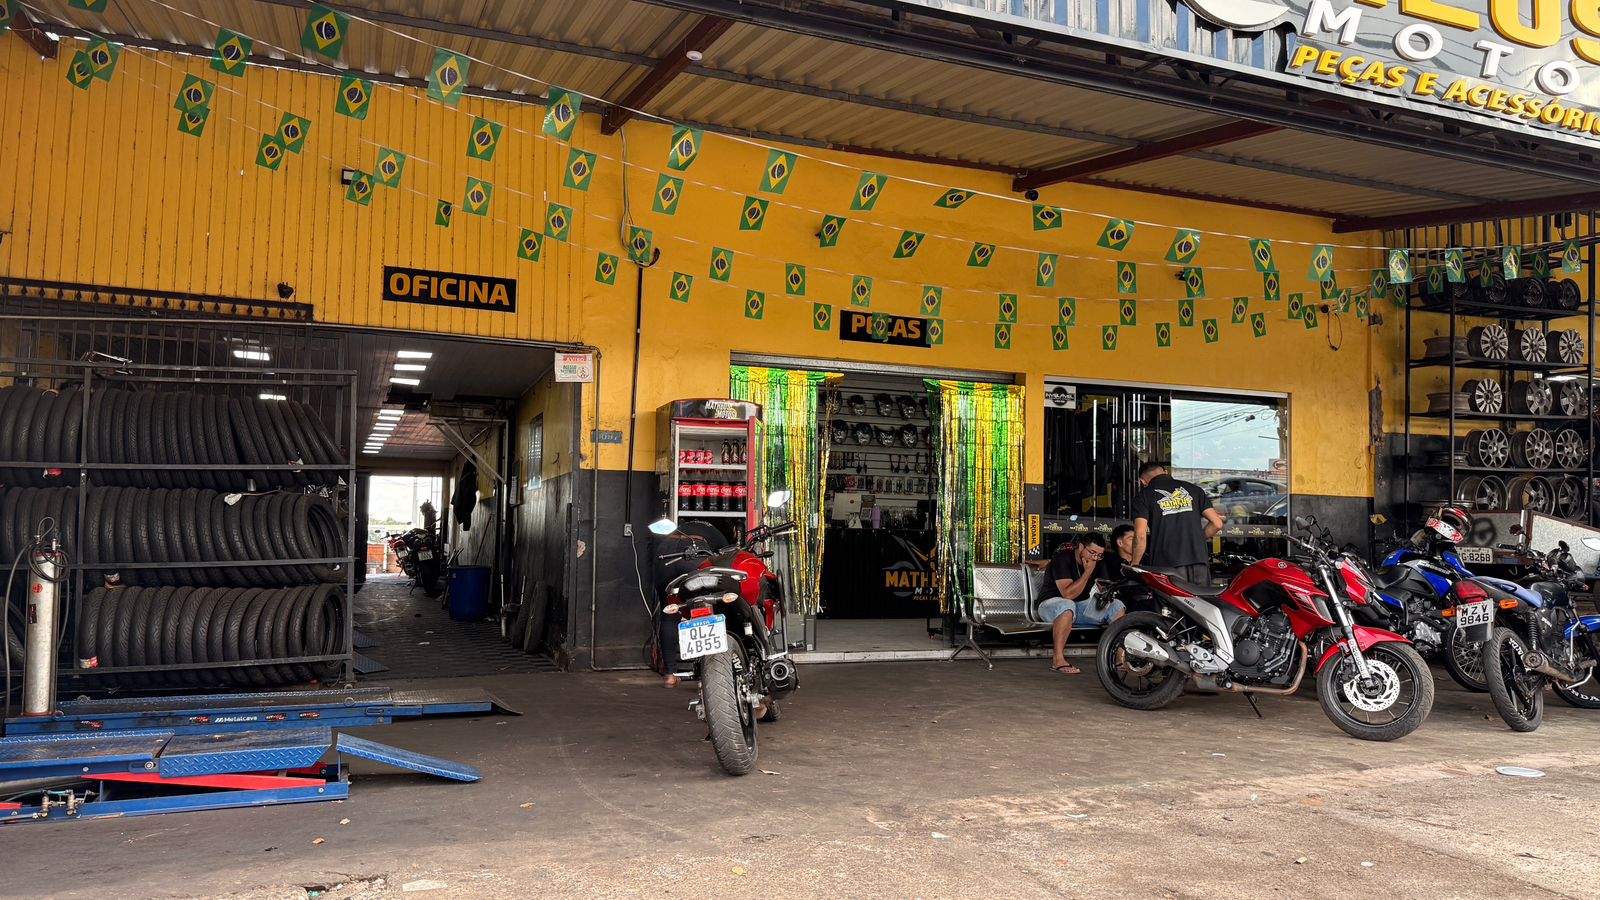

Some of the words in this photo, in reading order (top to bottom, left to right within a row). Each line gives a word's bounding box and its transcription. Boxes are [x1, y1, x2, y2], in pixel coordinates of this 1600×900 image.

[1291, 45, 1409, 88] PEÇAS
[1414, 72, 1440, 96] E
[389, 272, 510, 306] OFICINA
[1460, 612, 1489, 625] 9846
[1461, 604, 1488, 617] MZV
[690, 624, 716, 641] QLZ
[687, 636, 721, 655] 4B55
